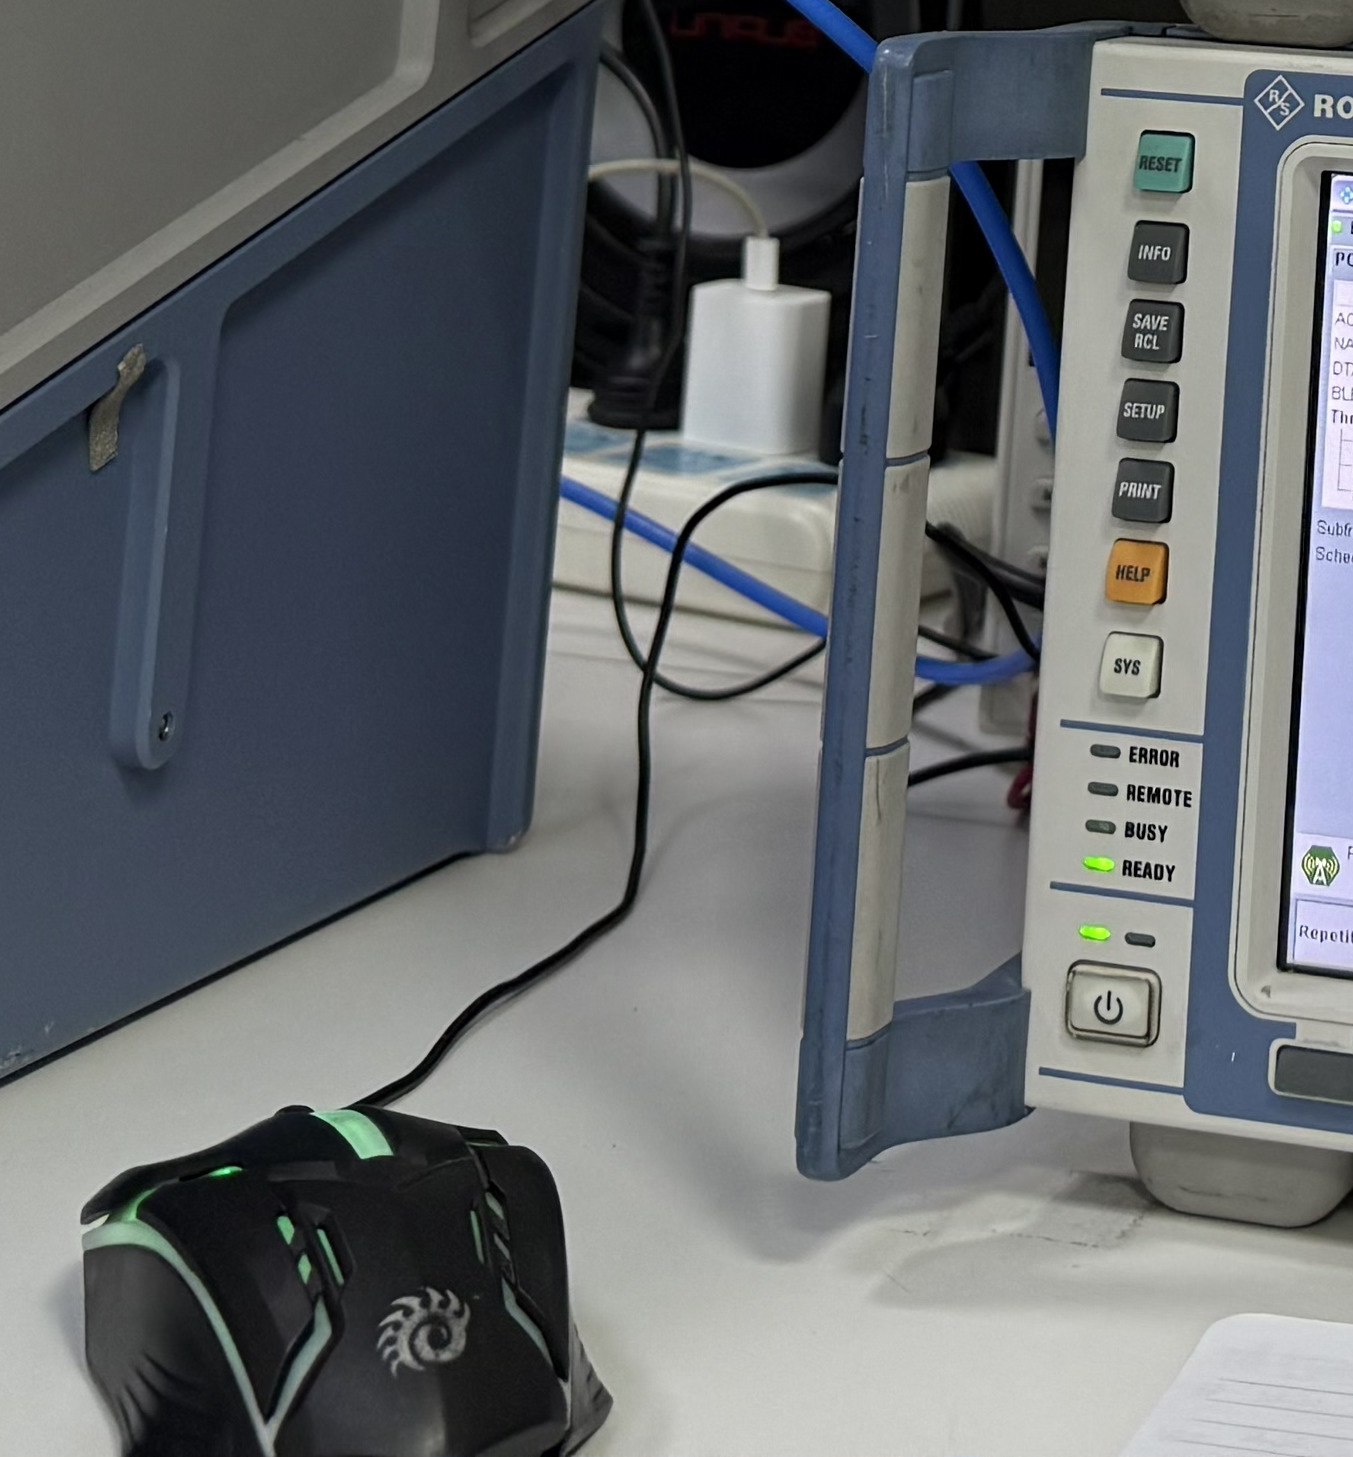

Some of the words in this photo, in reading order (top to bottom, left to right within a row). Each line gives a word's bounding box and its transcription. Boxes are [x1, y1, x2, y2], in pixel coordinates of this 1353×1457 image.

[1138, 154, 1183, 174] RESET
[1138, 244, 1172, 261] INFO
[1132, 313, 1170, 331] SAVE
[1134, 332, 1160, 351] RCL
[1123, 401, 1166, 420] SETUP
[1118, 481, 1162, 500] PRINT
[1115, 564, 1151, 583] HELP
[1113, 657, 1142, 677] SYS
[1128, 745, 1180, 769] ERROR
[1126, 783, 1193, 808] REMOTE
[1124, 821, 1168, 843] BUSY
[1121, 859, 1176, 883] READY
